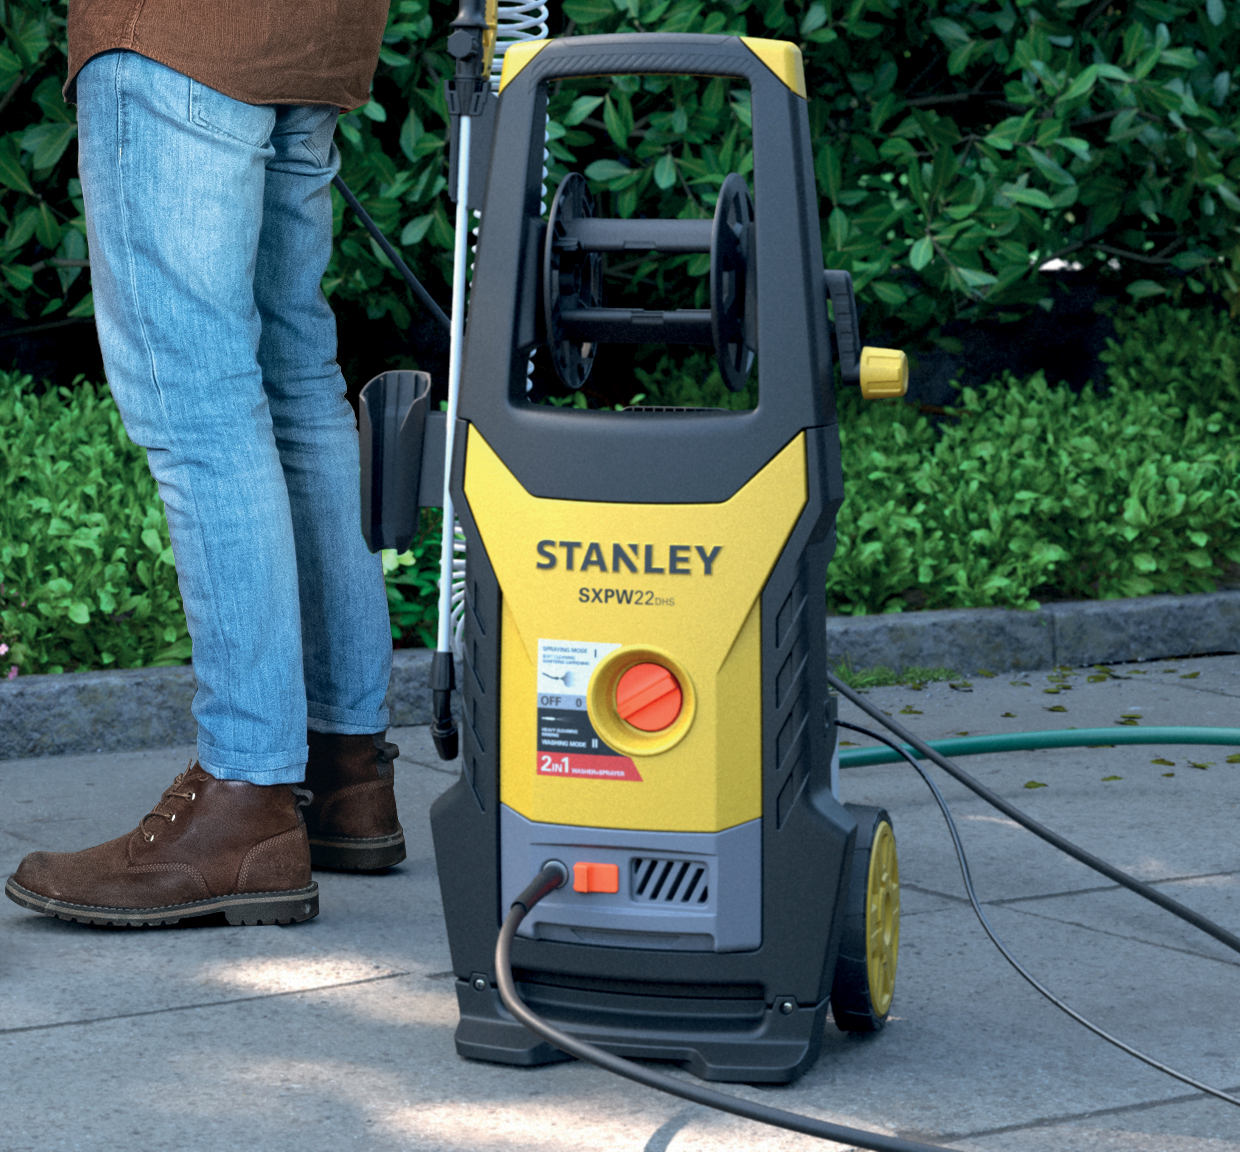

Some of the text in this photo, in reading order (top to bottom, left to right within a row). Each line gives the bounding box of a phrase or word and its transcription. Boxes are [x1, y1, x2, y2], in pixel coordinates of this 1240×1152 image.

[536, 539, 723, 576] STANLEY
[540, 695, 582, 708] OFF 0
[541, 739, 569, 747] WASHING
